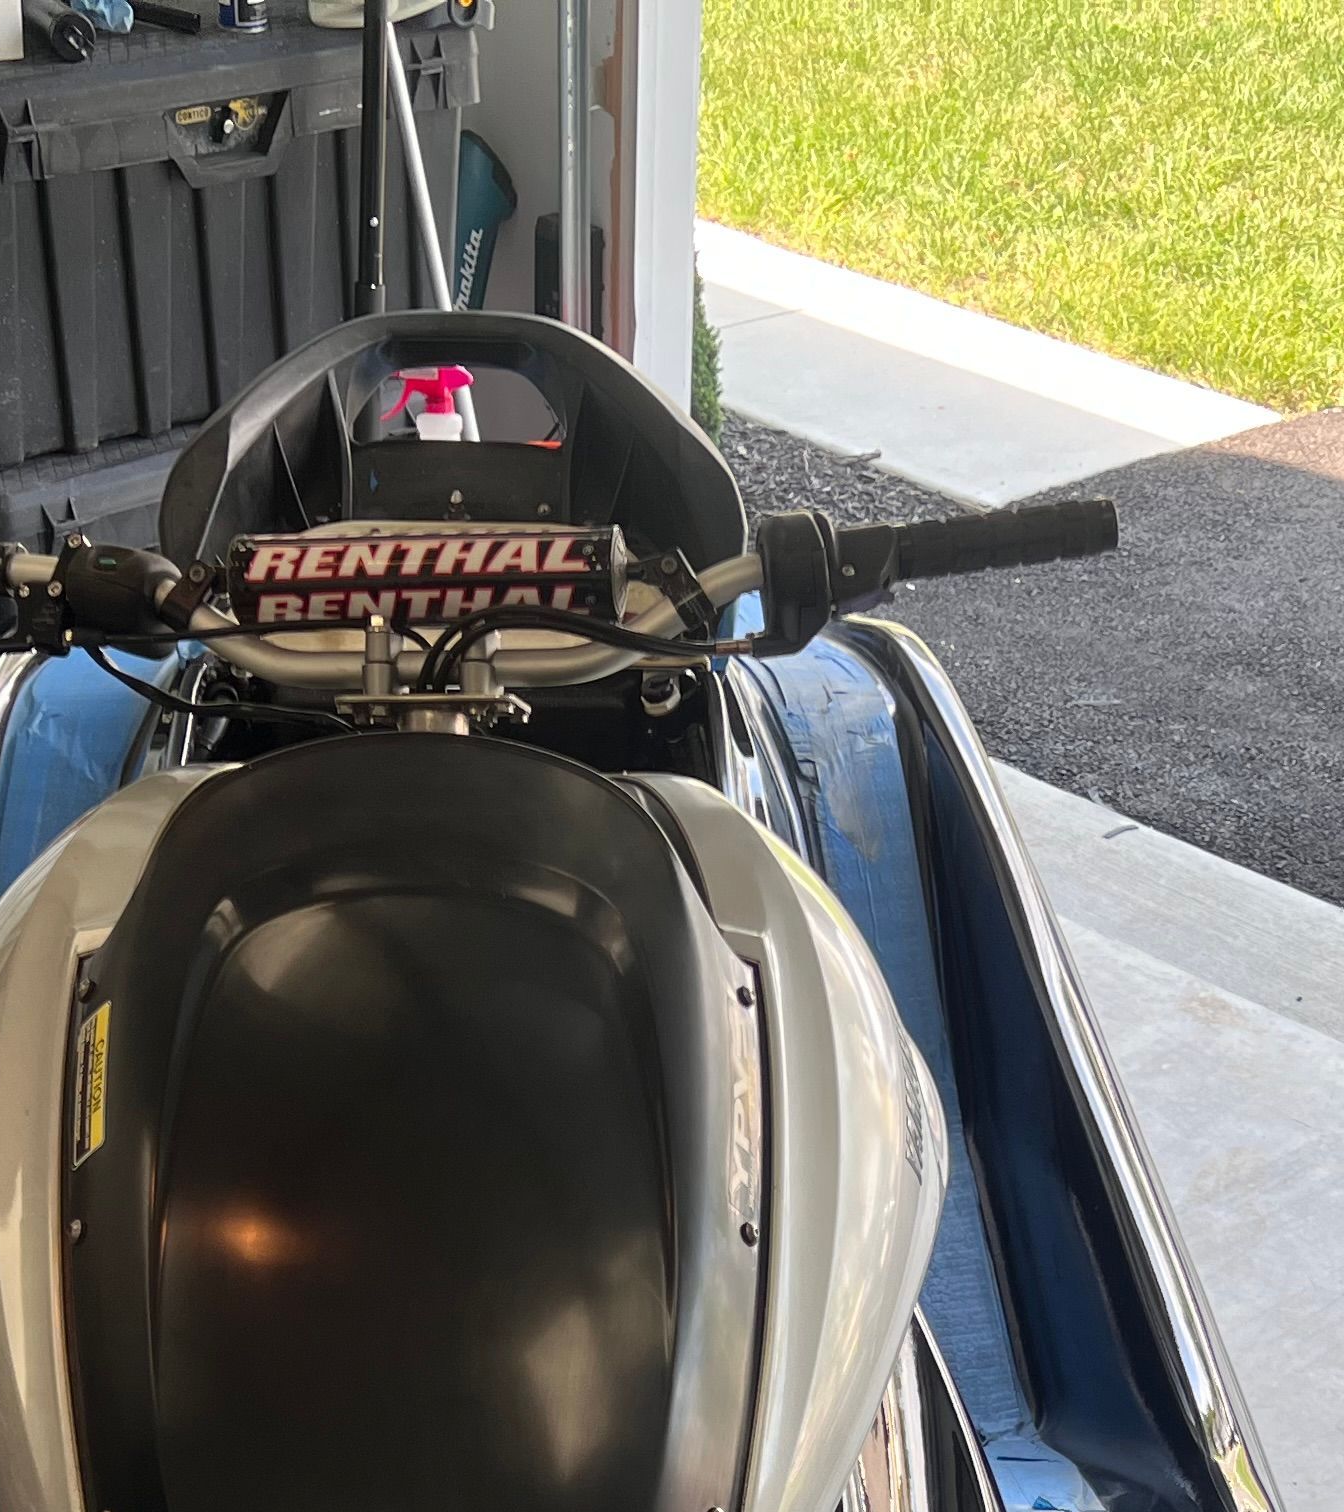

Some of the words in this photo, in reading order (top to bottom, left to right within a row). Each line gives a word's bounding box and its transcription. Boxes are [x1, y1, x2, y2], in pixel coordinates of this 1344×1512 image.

[453, 228, 483, 312] makita
[244, 536, 591, 584] RENTHAL
[91, 1038, 105, 1114] CAUTION
